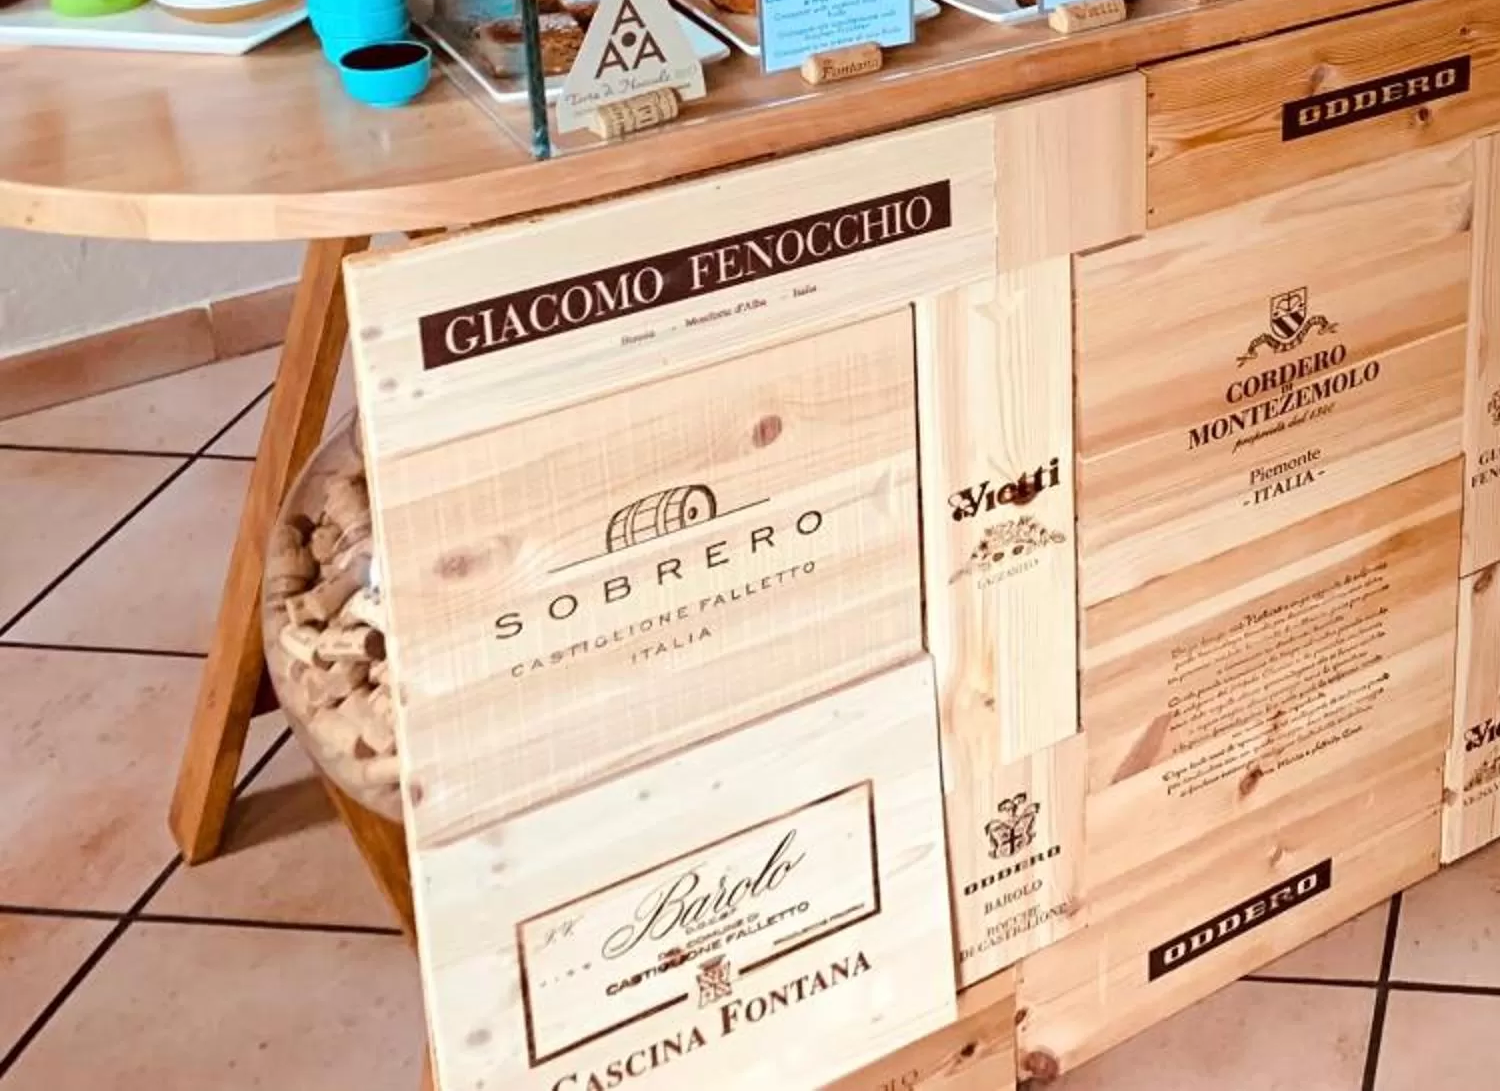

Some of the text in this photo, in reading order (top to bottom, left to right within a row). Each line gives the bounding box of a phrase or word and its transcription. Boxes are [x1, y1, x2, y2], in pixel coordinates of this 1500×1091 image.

[1297, 68, 1457, 127] ODDERO
[444, 194, 933, 357] GIACOMO FENOCCHIO
[734, 297, 768, 314] d'Alba
[792, 283, 818, 298] Italia
[1187, 360, 1381, 450] MONTEZEMOLO
[1226, 343, 1347, 405] CORDERO
[1281, 382, 1293, 394] DI
[948, 457, 1061, 521] Vietti
[1250, 446, 1323, 486] Piemonte
[494, 509, 823, 640] SOBRERO
[511, 560, 816, 678] CASTIGLIONE FALLETTO
[631, 626, 713, 665] ITALIA
[602, 828, 806, 960] Barolo
[963, 844, 1061, 897] ODDERO
[984, 878, 1044, 917] BAROLO
[605, 939, 723, 997] CASTIGLIONE
[725, 900, 811, 944] FALLETTO
[1163, 873, 1318, 966] ODDERO
[550, 949, 873, 1091] CASCINA FONTANA
